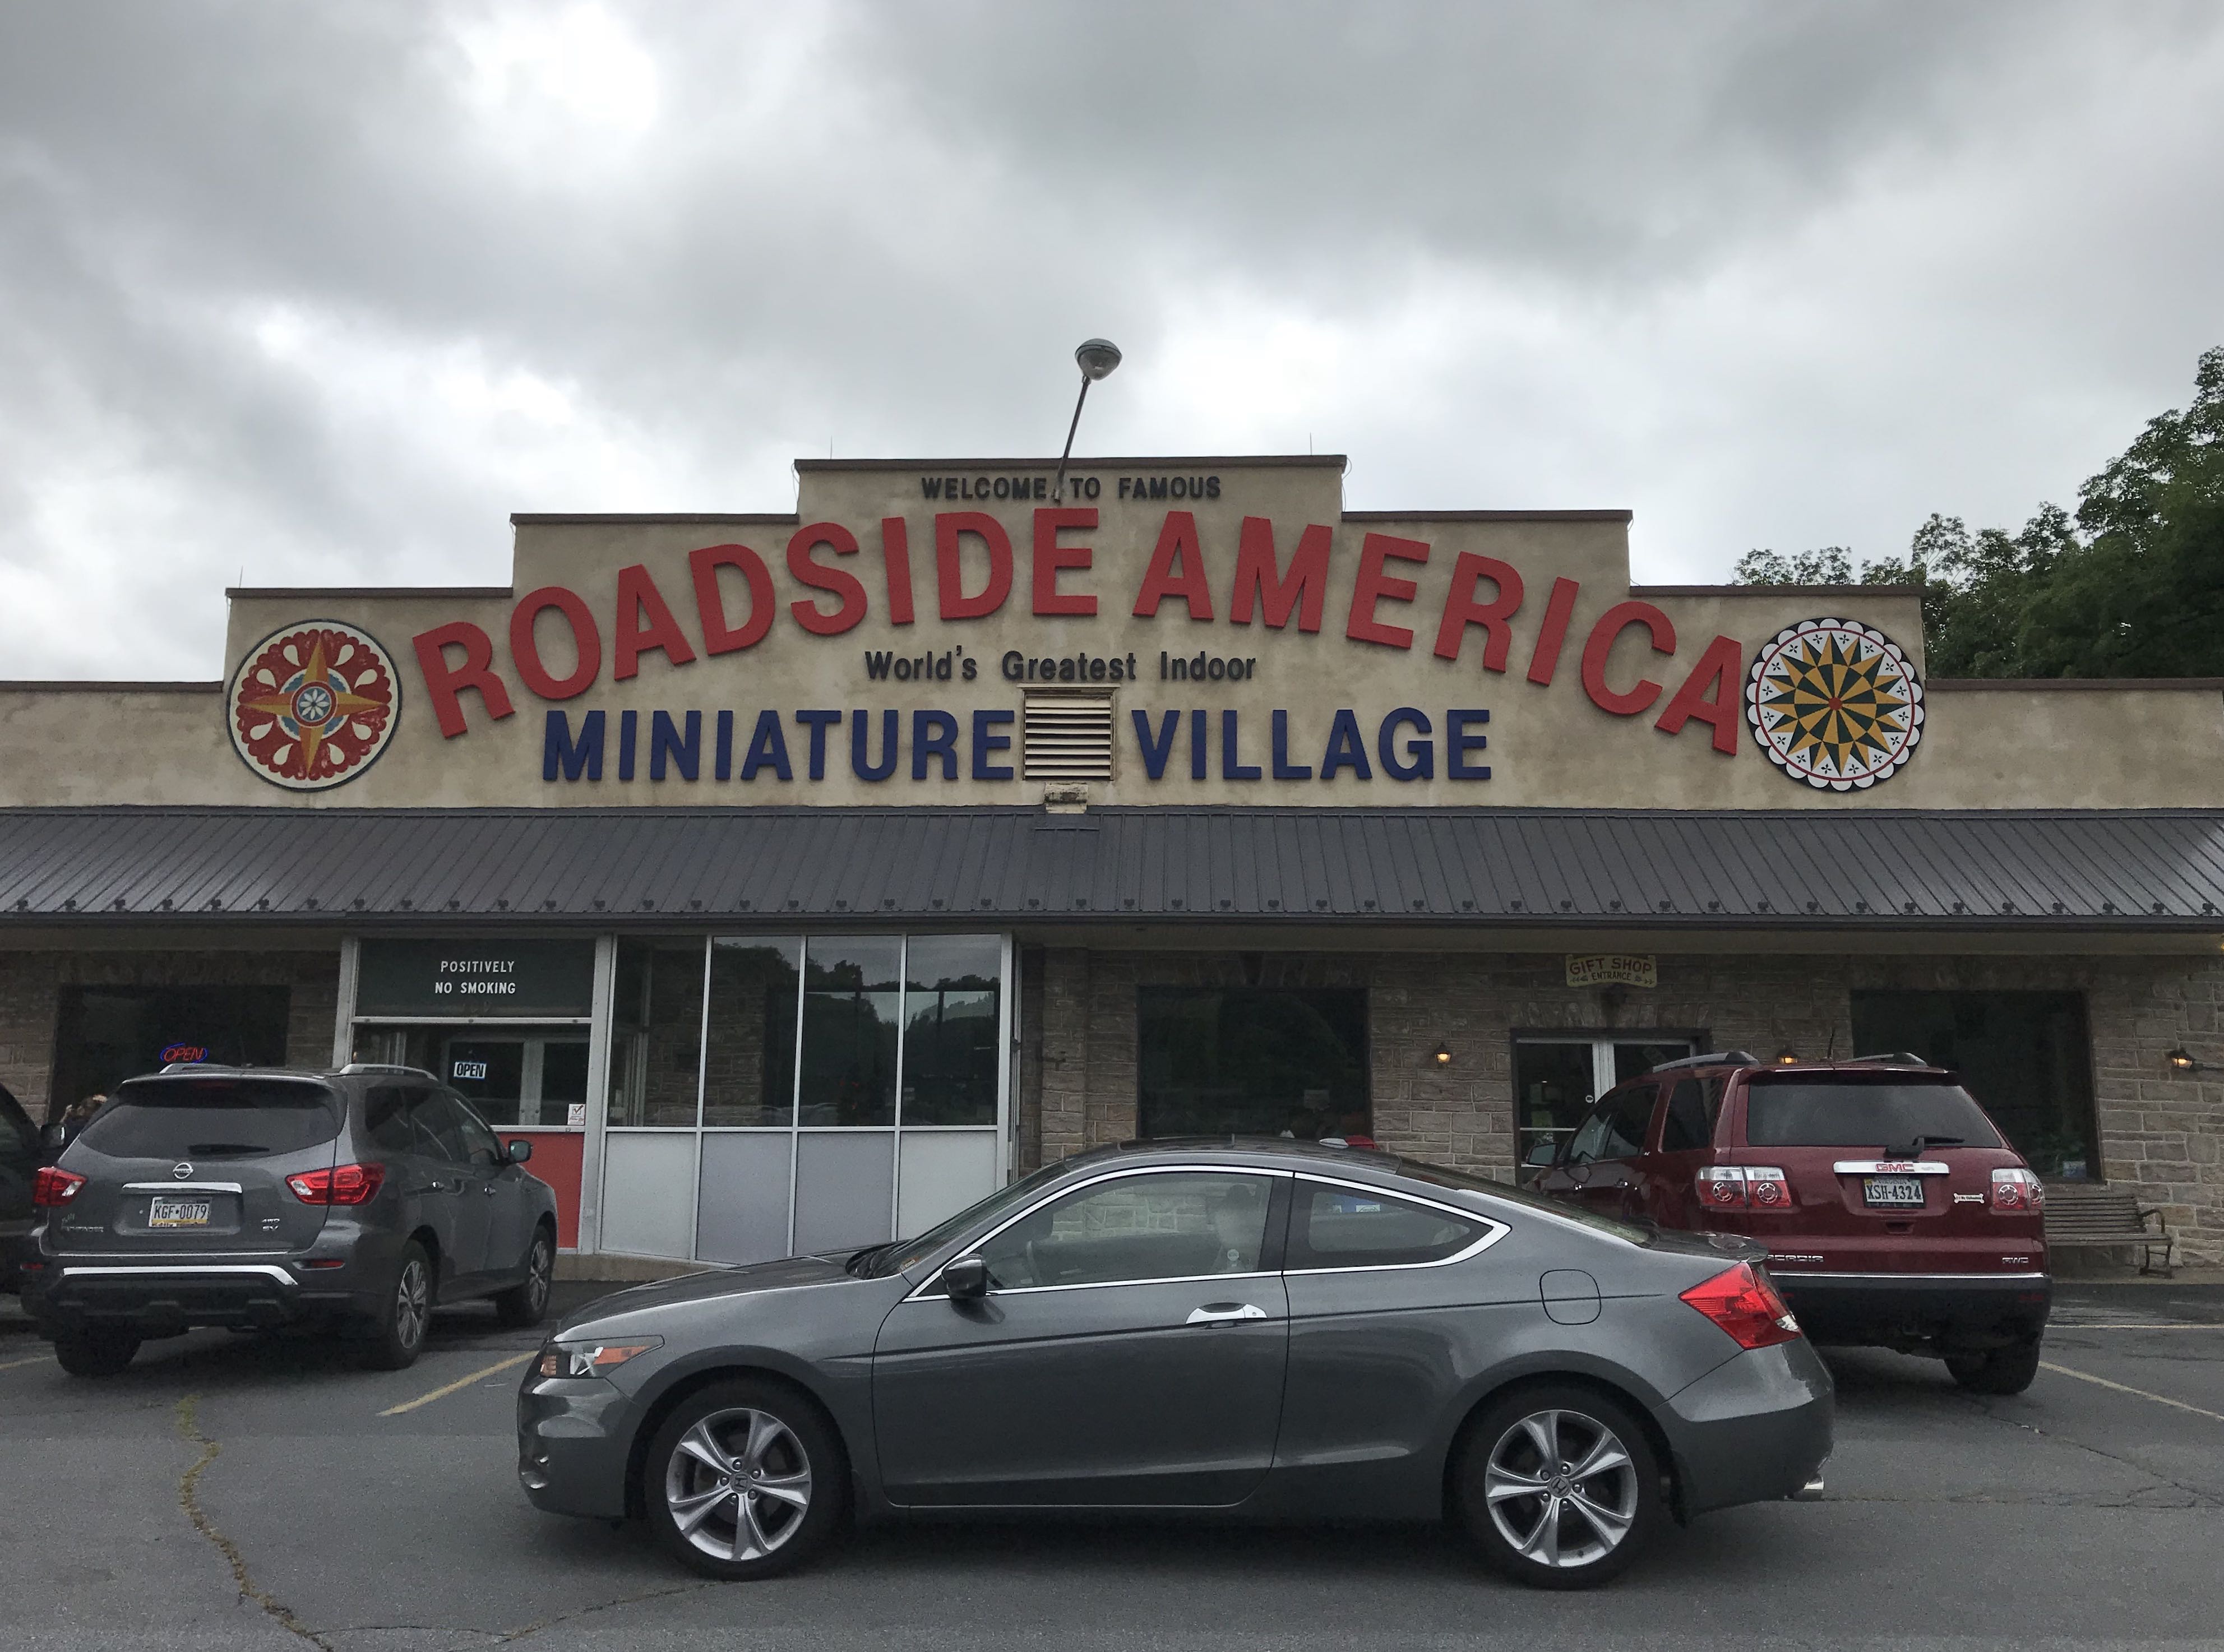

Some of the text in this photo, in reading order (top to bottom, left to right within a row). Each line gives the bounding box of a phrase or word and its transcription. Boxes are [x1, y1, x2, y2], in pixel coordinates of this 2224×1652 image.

[922, 476, 1221, 501] WELCOME TO FAMOUS
[412, 508, 1741, 756] ROADSIDE AMERICA
[864, 645, 1256, 683] World's Greatest Indoor
[543, 707, 1491, 780] MINIATURE VILLAGE
[441, 961, 515, 973] POSITIVELY
[1569, 957, 1652, 975] GIFT SHOP
[1591, 971, 1631, 981] ENTRANCE
[435, 982, 516, 994] NO SMOKING
[164, 1047, 204, 1062] OPEN
[456, 1063, 484, 1077] OPEN
[1875, 1163, 1915, 1172] GMC
[1866, 1184, 1921, 1200] XSH-4324
